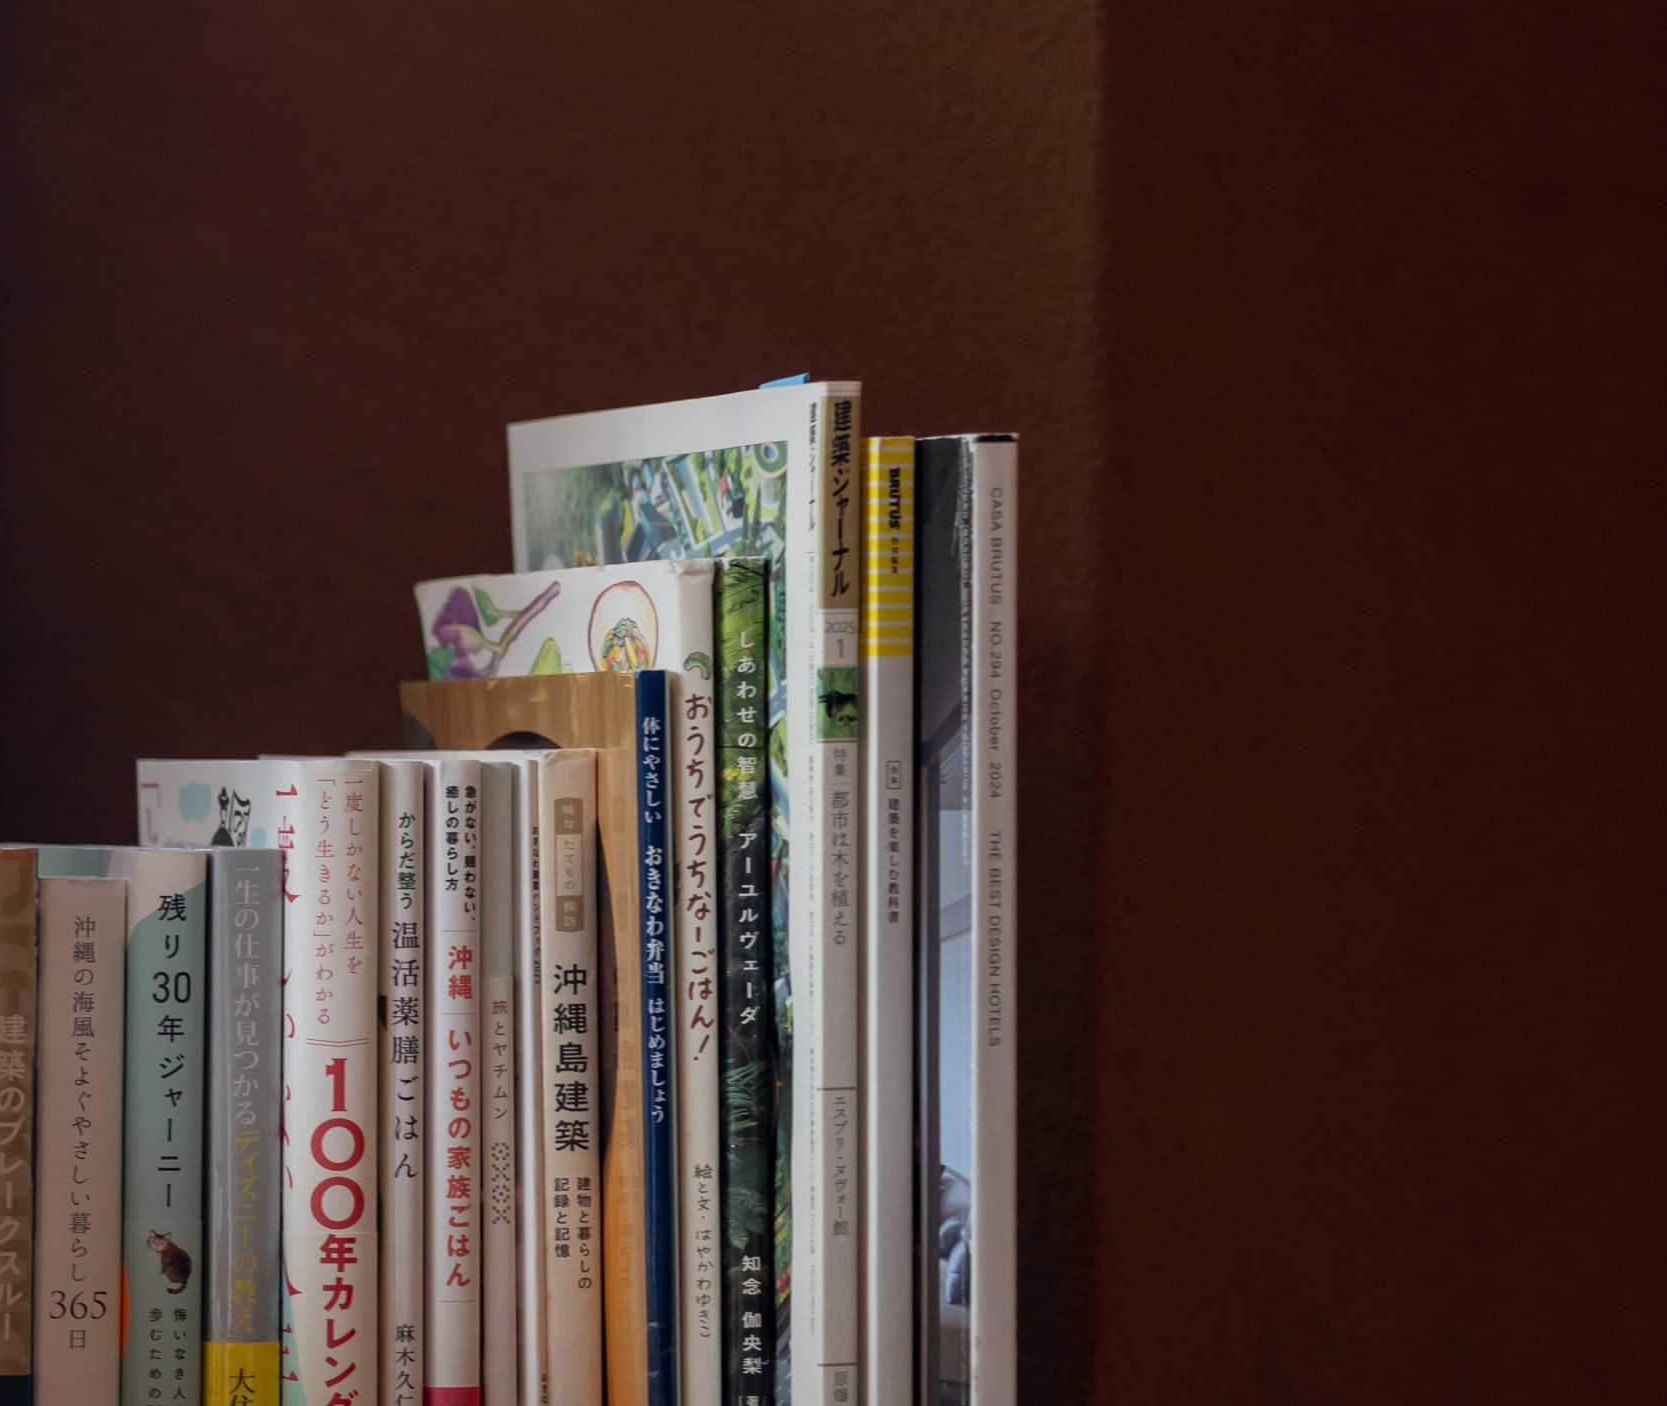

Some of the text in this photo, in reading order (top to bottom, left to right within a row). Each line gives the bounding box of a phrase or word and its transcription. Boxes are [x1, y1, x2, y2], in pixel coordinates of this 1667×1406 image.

[888, 467, 901, 530] BRUTUS
[825, 622, 857, 635] 2025
[836, 640, 845, 658] 1
[444, 786, 459, 892] 癒しの暮らし方
[737, 628, 761, 1025] しあわせの智慧 アーユルヴェーダ
[831, 748, 850, 947] 特集 都市は木を植える
[887, 798, 900, 923] 建築を楽しむ教科書
[986, 487, 1004, 1047] CASA BRUTUS NO.294 October 2024 THE BEST DESIGN HOTELS
[313, 779, 335, 1026] 「どう生きるか」がわかる
[343, 780, 364, 976] 一度しかない人生を
[641, 717, 667, 1124] 体にやさしい おきなわ弁当 はじめましょう
[152, 893, 192, 1208] 残り30年ジャーニー
[390, 812, 421, 1179] からだ整う 温活薬膳ごはん
[491, 1000, 509, 1120] 旅とヤチムン
[553, 964, 591, 1152] 沖縄島建築
[231, 867, 261, 1333] 一生の仕事が見つかるディズニーの教え
[447, 945, 474, 1287] 沖縄 いつもの家族ごはん
[554, 1177, 572, 1259] 記録と記憶
[576, 1177, 593, 1290] 建物と暮らしの
[741, 1254, 762, 1296] 知念
[742, 1311, 764, 1375] 伽央梨
